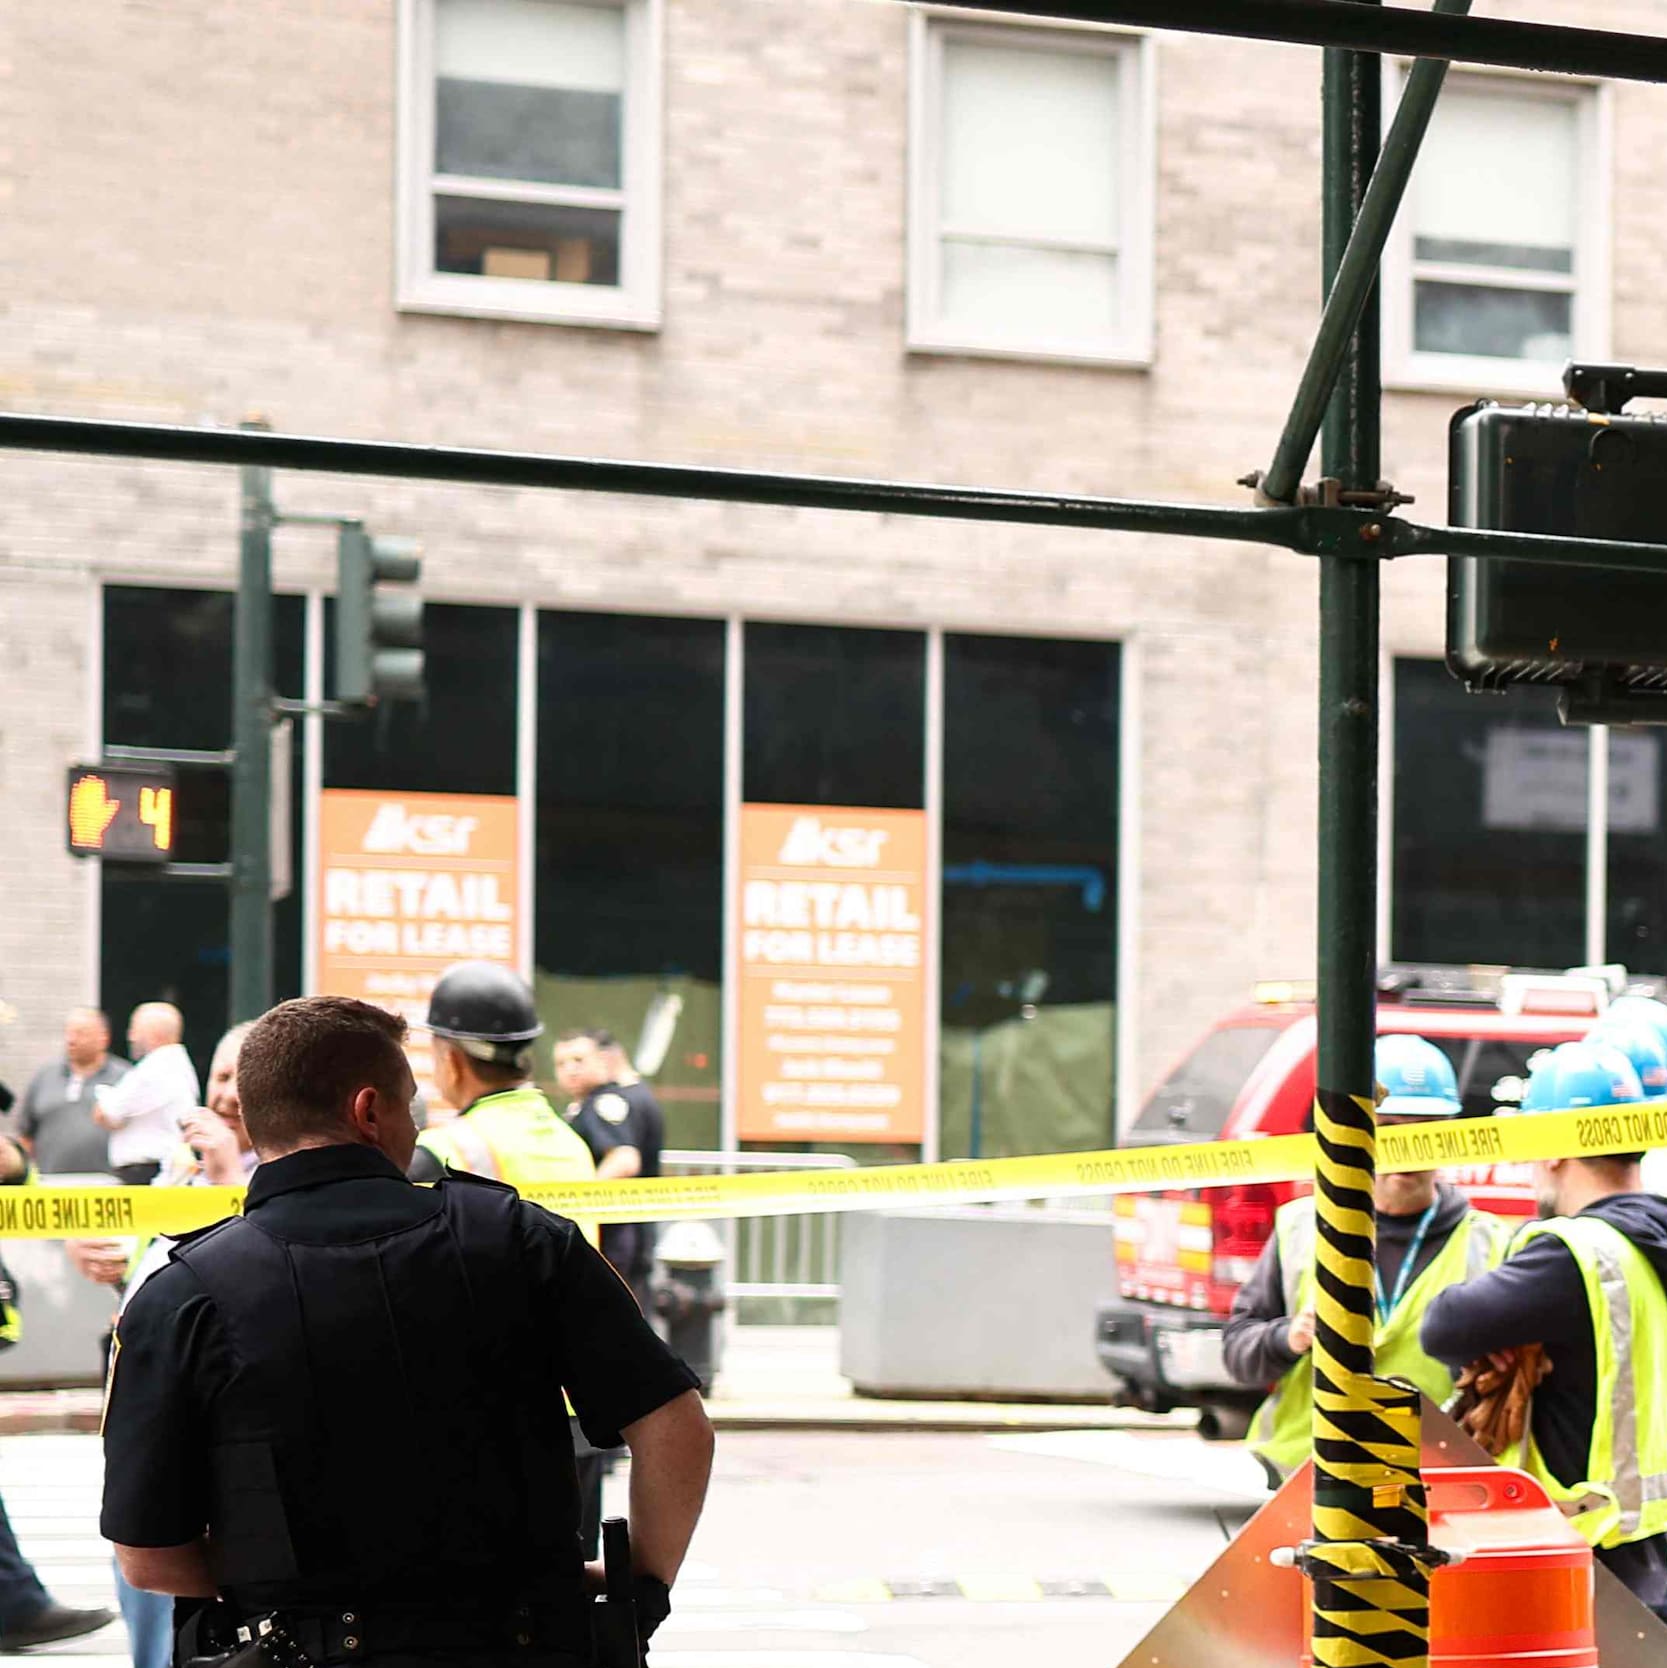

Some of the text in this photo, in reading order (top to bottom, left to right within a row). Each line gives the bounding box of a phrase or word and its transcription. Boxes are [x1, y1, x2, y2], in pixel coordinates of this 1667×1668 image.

[139, 786, 172, 851] 4
[325, 869, 510, 920] RETAIL
[743, 879, 920, 931] RETAIL
[325, 921, 511, 957] FOR LEASE
[743, 930, 920, 967] FOR LEASE
